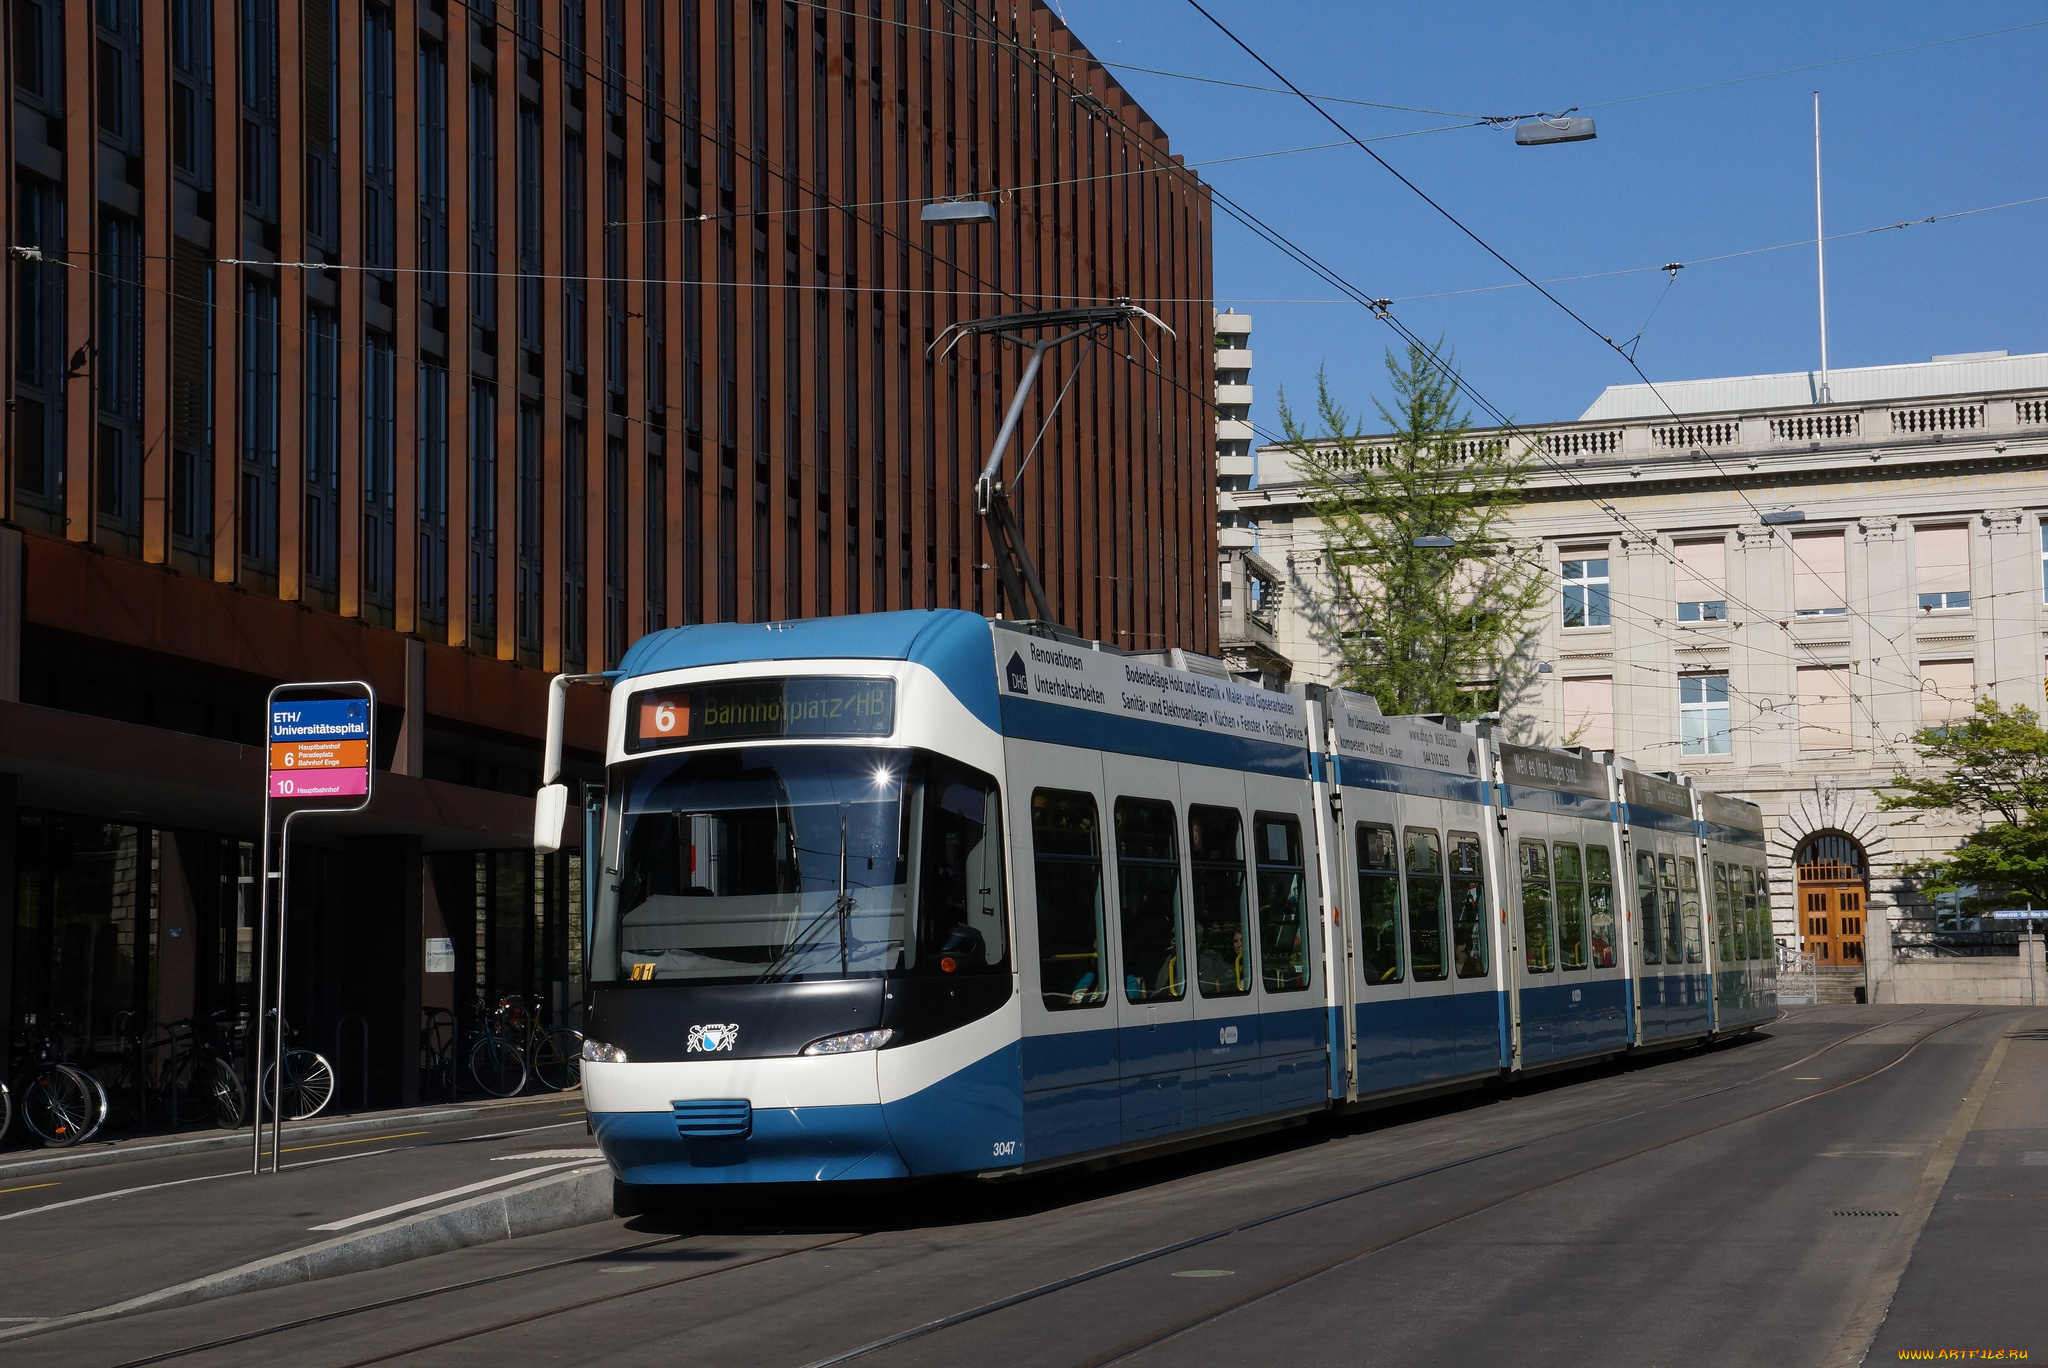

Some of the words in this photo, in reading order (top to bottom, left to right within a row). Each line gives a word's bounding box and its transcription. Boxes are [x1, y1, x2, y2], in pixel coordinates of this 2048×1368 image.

[1030, 642, 1083, 671] Renovationen
[1011, 673, 1027, 691] DHG
[1034, 674, 1105, 705] Unterhaltsarbeiten
[1125, 664, 1169, 693] Bodenbeläge
[1168, 674, 1184, 693] Holz
[1184, 679, 1197, 696] und
[1196, 680, 1221, 700] Keramik
[1245, 692, 1256, 708] und
[1255, 693, 1294, 715] Gipserarbeiten
[273, 711, 301, 723] ETH/
[655, 701, 676, 732] 6
[704, 690, 885, 725] Bahnhofplatz/HB
[1121, 691, 1149, 712] Sanitär-
[1149, 698, 1163, 716] und
[1162, 700, 1209, 727] Elektroanlagen
[1213, 709, 1237, 729] Küchen
[1240, 715, 1261, 733] Fenster
[1265, 720, 1285, 741] Facility
[1284, 723, 1304, 741] Service
[273, 722, 364, 736] Universitätsspital
[298, 743, 341, 751] Hauptbahnhof
[1339, 733, 1366, 754] kompetent
[1369, 739, 1385, 756] schnell
[284, 752, 295, 767] 6
[298, 751, 334, 759] Paradeplatz
[324, 759, 340, 767] Enge
[1513, 753, 1528, 775] Weil
[1528, 760, 1536, 777] es
[1535, 756, 1548, 778] Ihre
[1548, 759, 1565, 786] Augen
[277, 779, 294, 795] 10
[297, 786, 340, 795] Hauptbahnhof
[993, 1141, 1016, 1156] 3047
